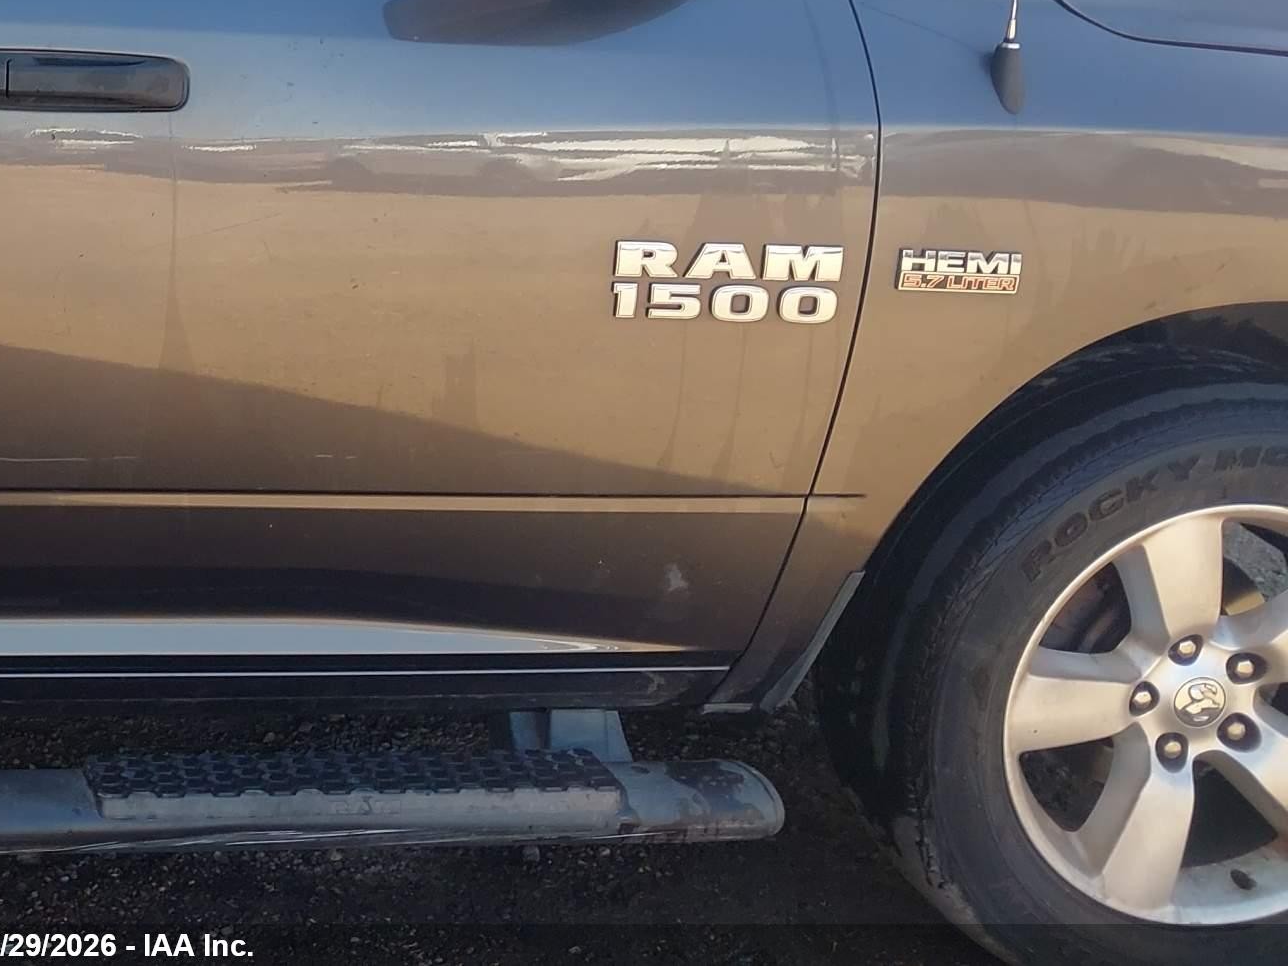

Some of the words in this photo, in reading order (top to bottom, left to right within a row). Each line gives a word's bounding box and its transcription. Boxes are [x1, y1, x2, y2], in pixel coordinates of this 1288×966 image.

[613, 240, 845, 282] RAM
[900, 248, 1023, 275] HEMI
[903, 273, 945, 289] 5.7
[946, 275, 1015, 291] LITER
[611, 281, 839, 324] 1500
[1021, 455, 1200, 582] ROCKY
